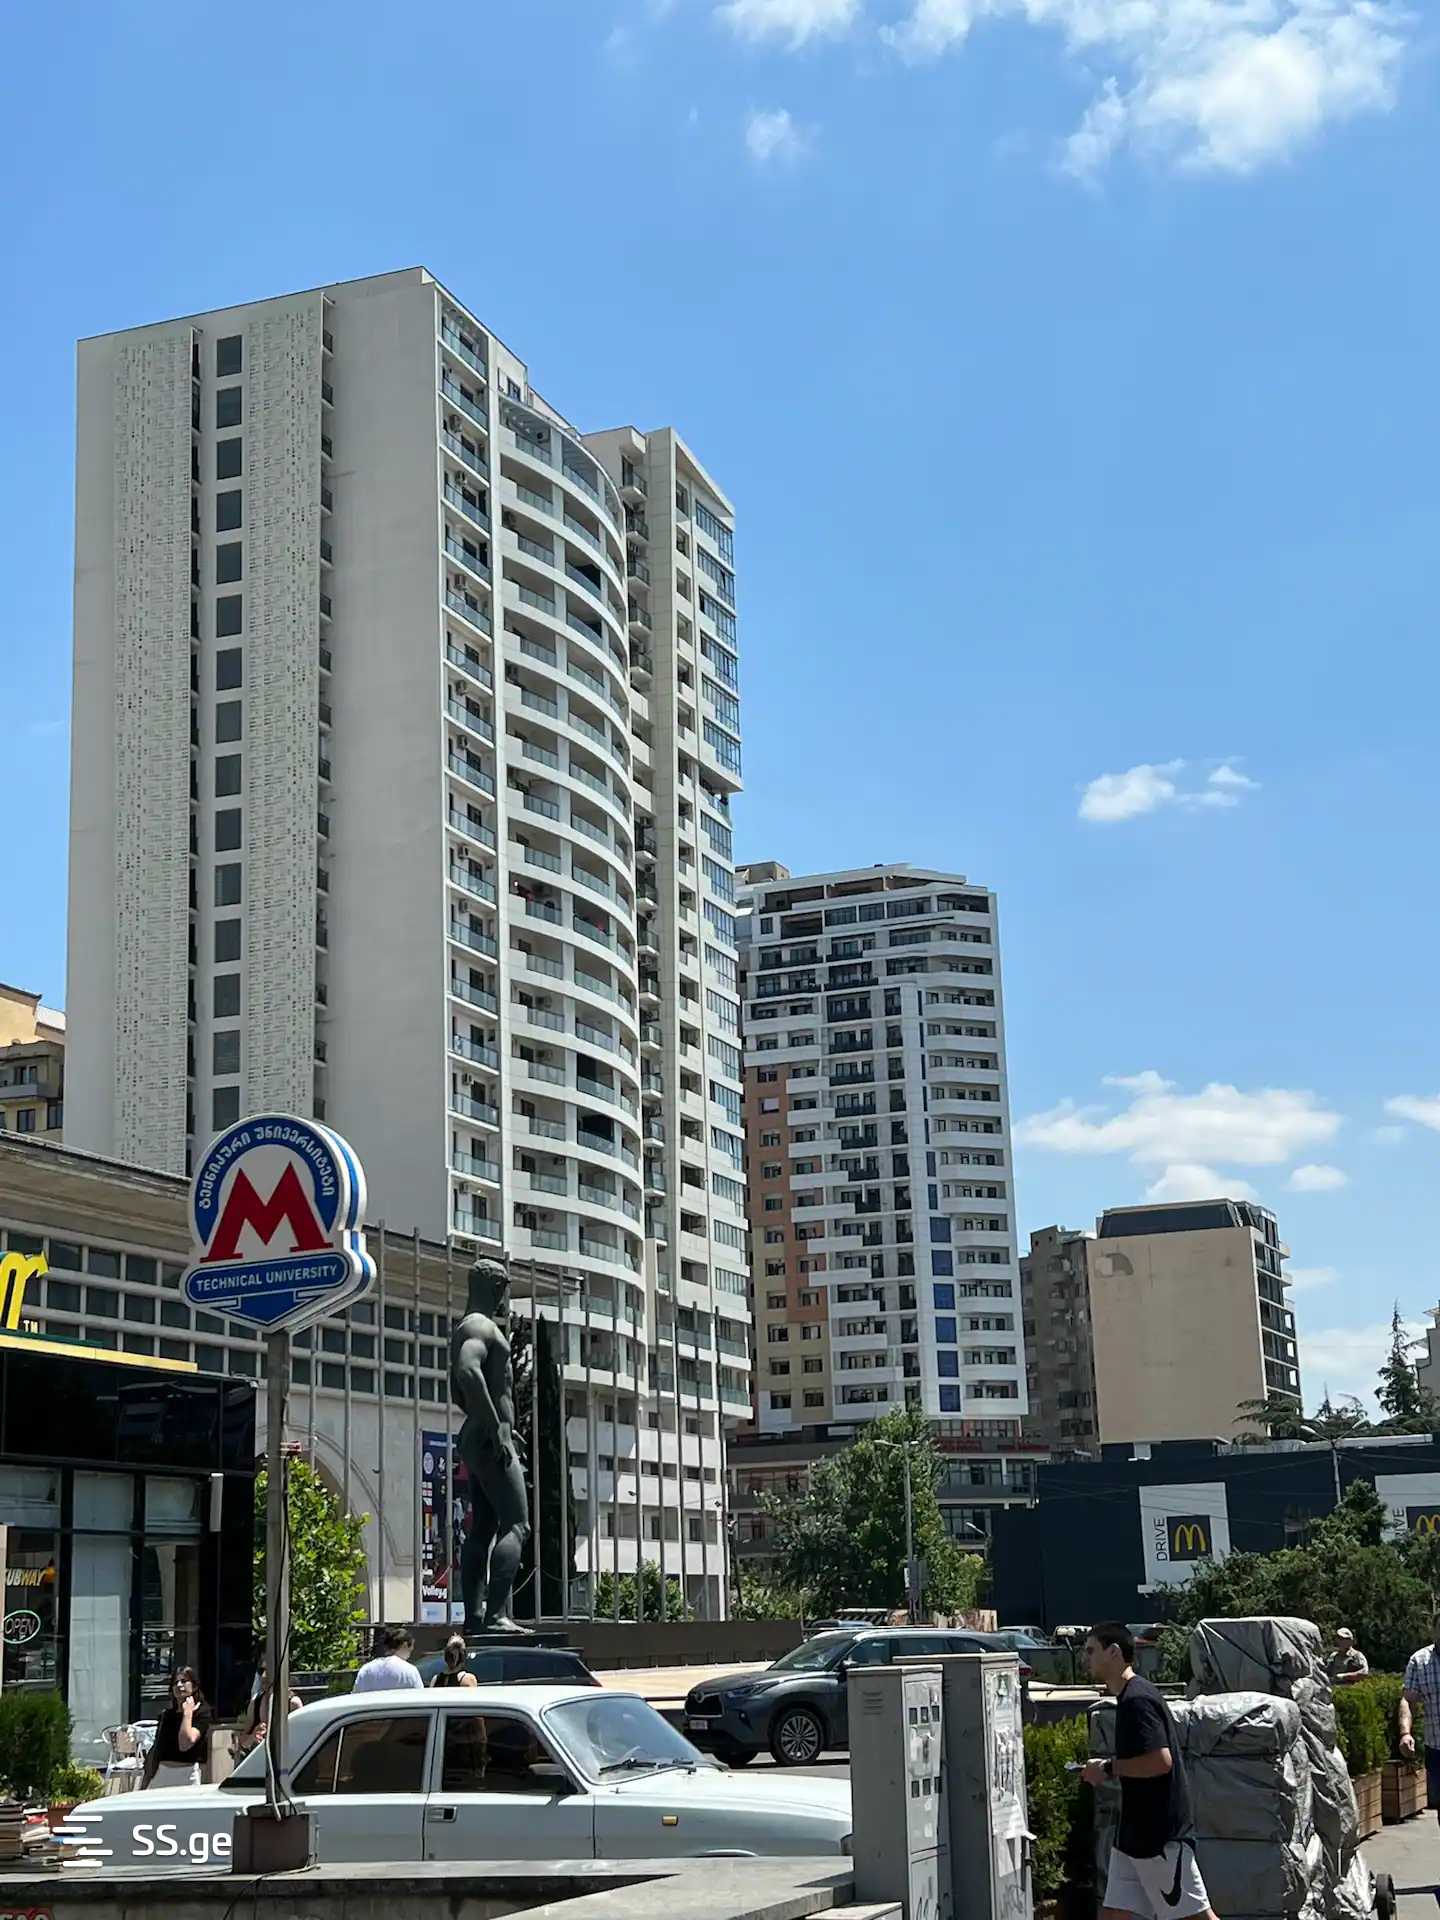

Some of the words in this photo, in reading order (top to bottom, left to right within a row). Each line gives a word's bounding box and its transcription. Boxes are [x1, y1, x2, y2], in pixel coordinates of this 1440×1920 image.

[196, 1272, 262, 1292] TECHNICAL
[265, 1264, 337, 1284] UNIVERSITY
[1153, 1517, 1169, 1561] DRIVE
[4, 1617, 36, 1635] OPEN
